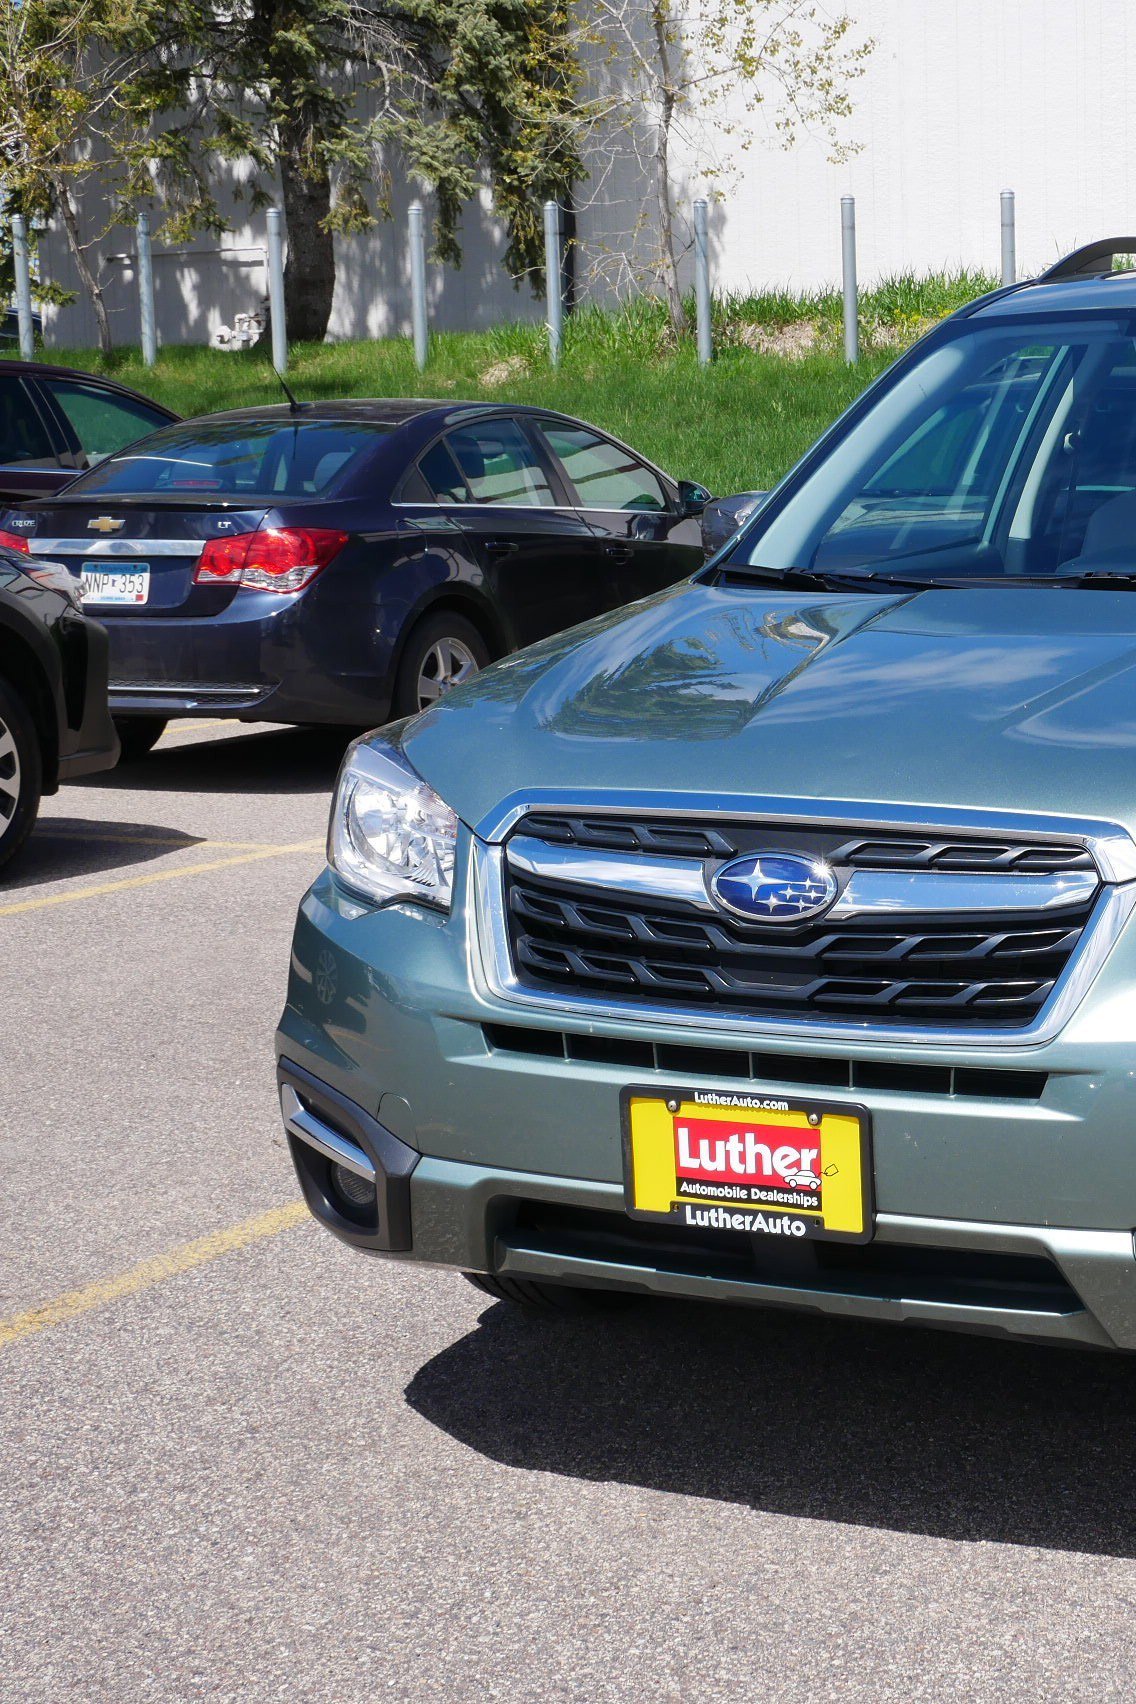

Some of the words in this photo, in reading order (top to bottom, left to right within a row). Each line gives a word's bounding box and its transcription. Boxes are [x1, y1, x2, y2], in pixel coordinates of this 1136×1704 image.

[218, 521, 232, 529] LT
[119, 573, 144, 593] 353
[694, 1091, 789, 1111] LutherAuto.com
[677, 1127, 818, 1178] Luther
[680, 1181, 748, 1199] Automobile
[750, 1190, 819, 1208] Dealerships
[685, 1204, 806, 1237] LutherAuto
